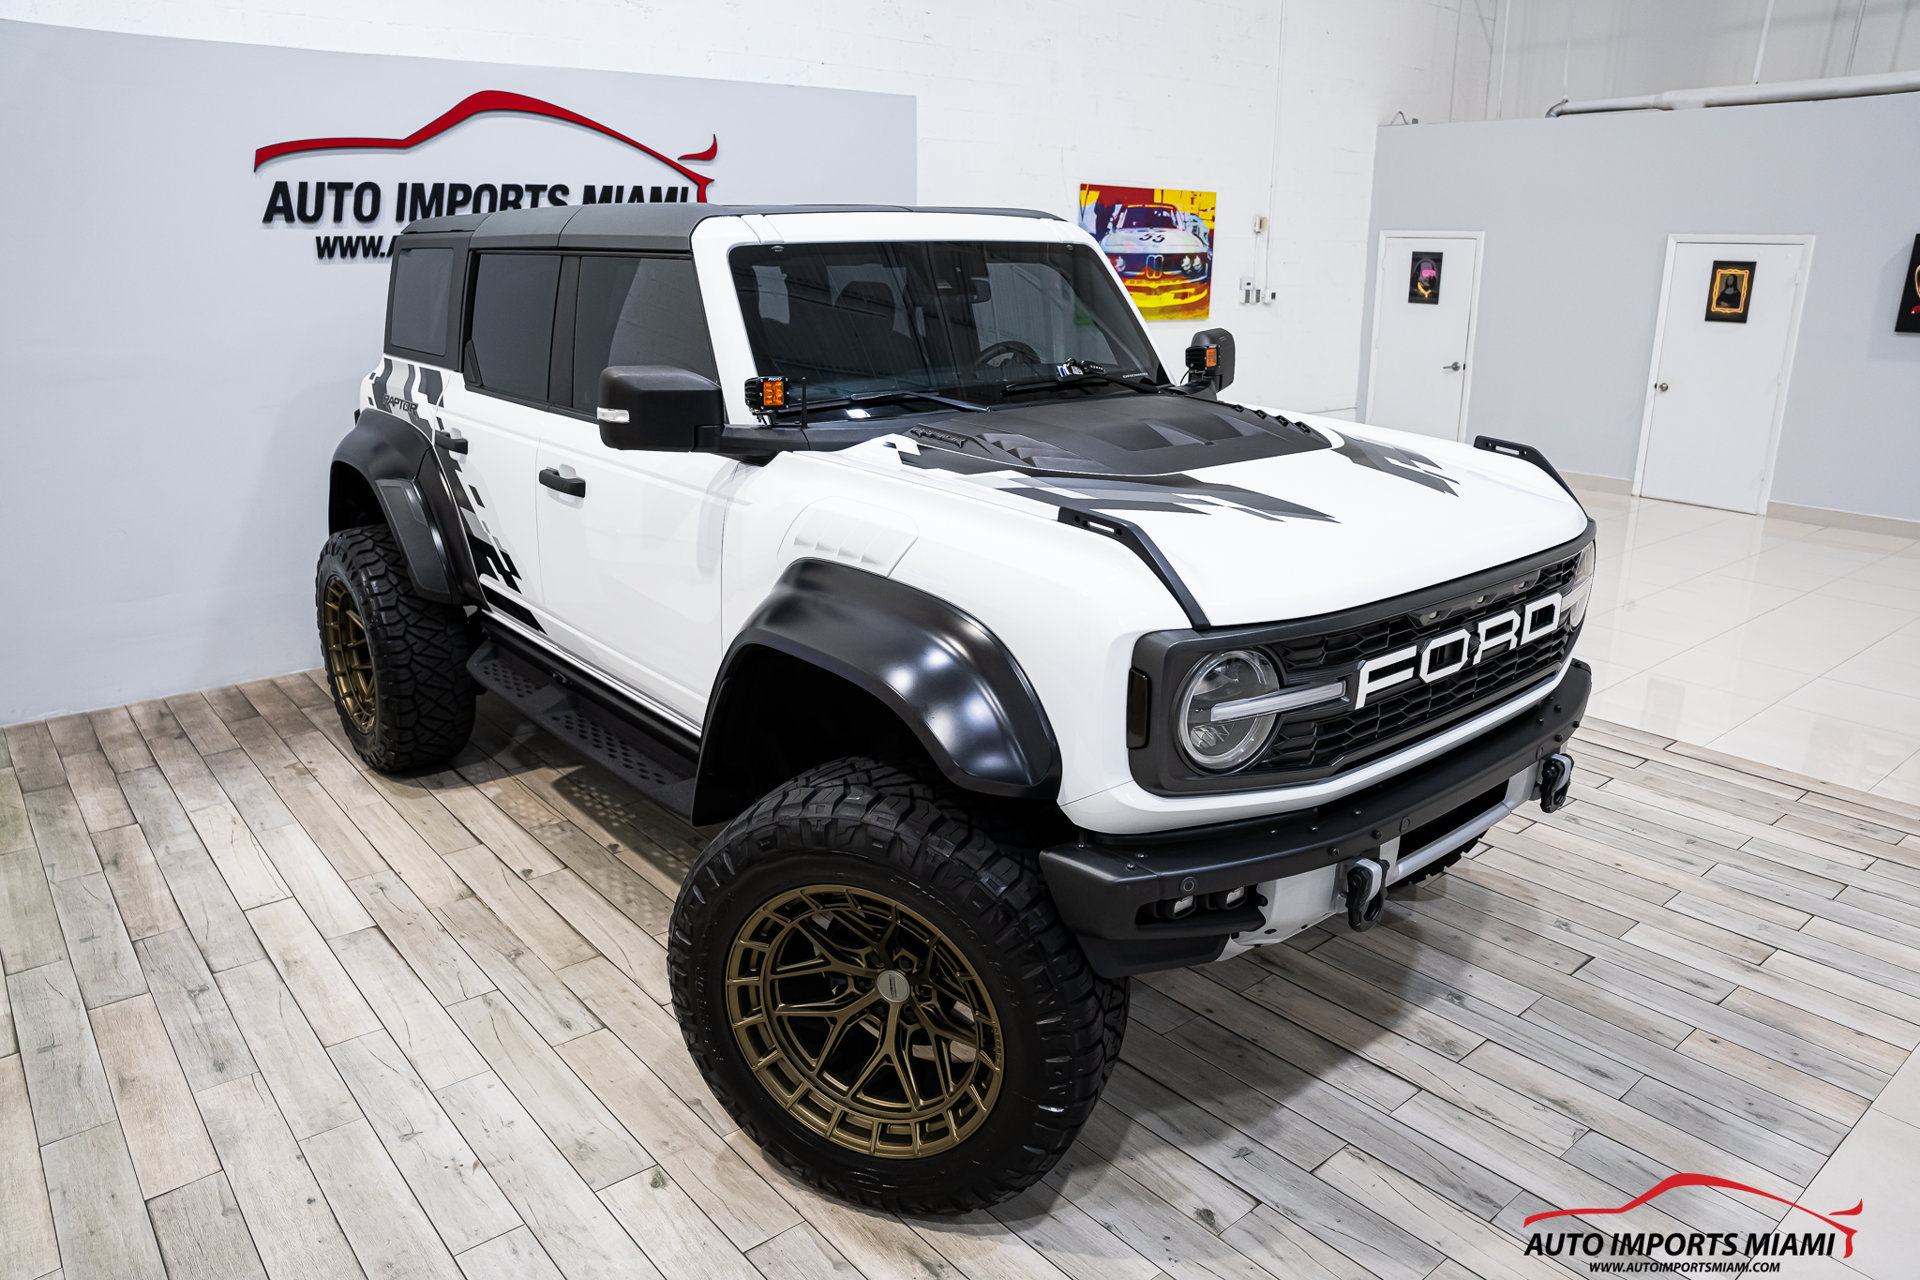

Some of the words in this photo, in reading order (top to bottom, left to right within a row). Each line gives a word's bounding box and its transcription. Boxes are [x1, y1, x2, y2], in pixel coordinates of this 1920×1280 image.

[262, 181, 381, 223] AUTO
[395, 182, 570, 222] IMPORTS
[1139, 233, 1166, 243] 55
[383, 393, 420, 420] RAPTOR
[1354, 592, 1562, 710] FORD
